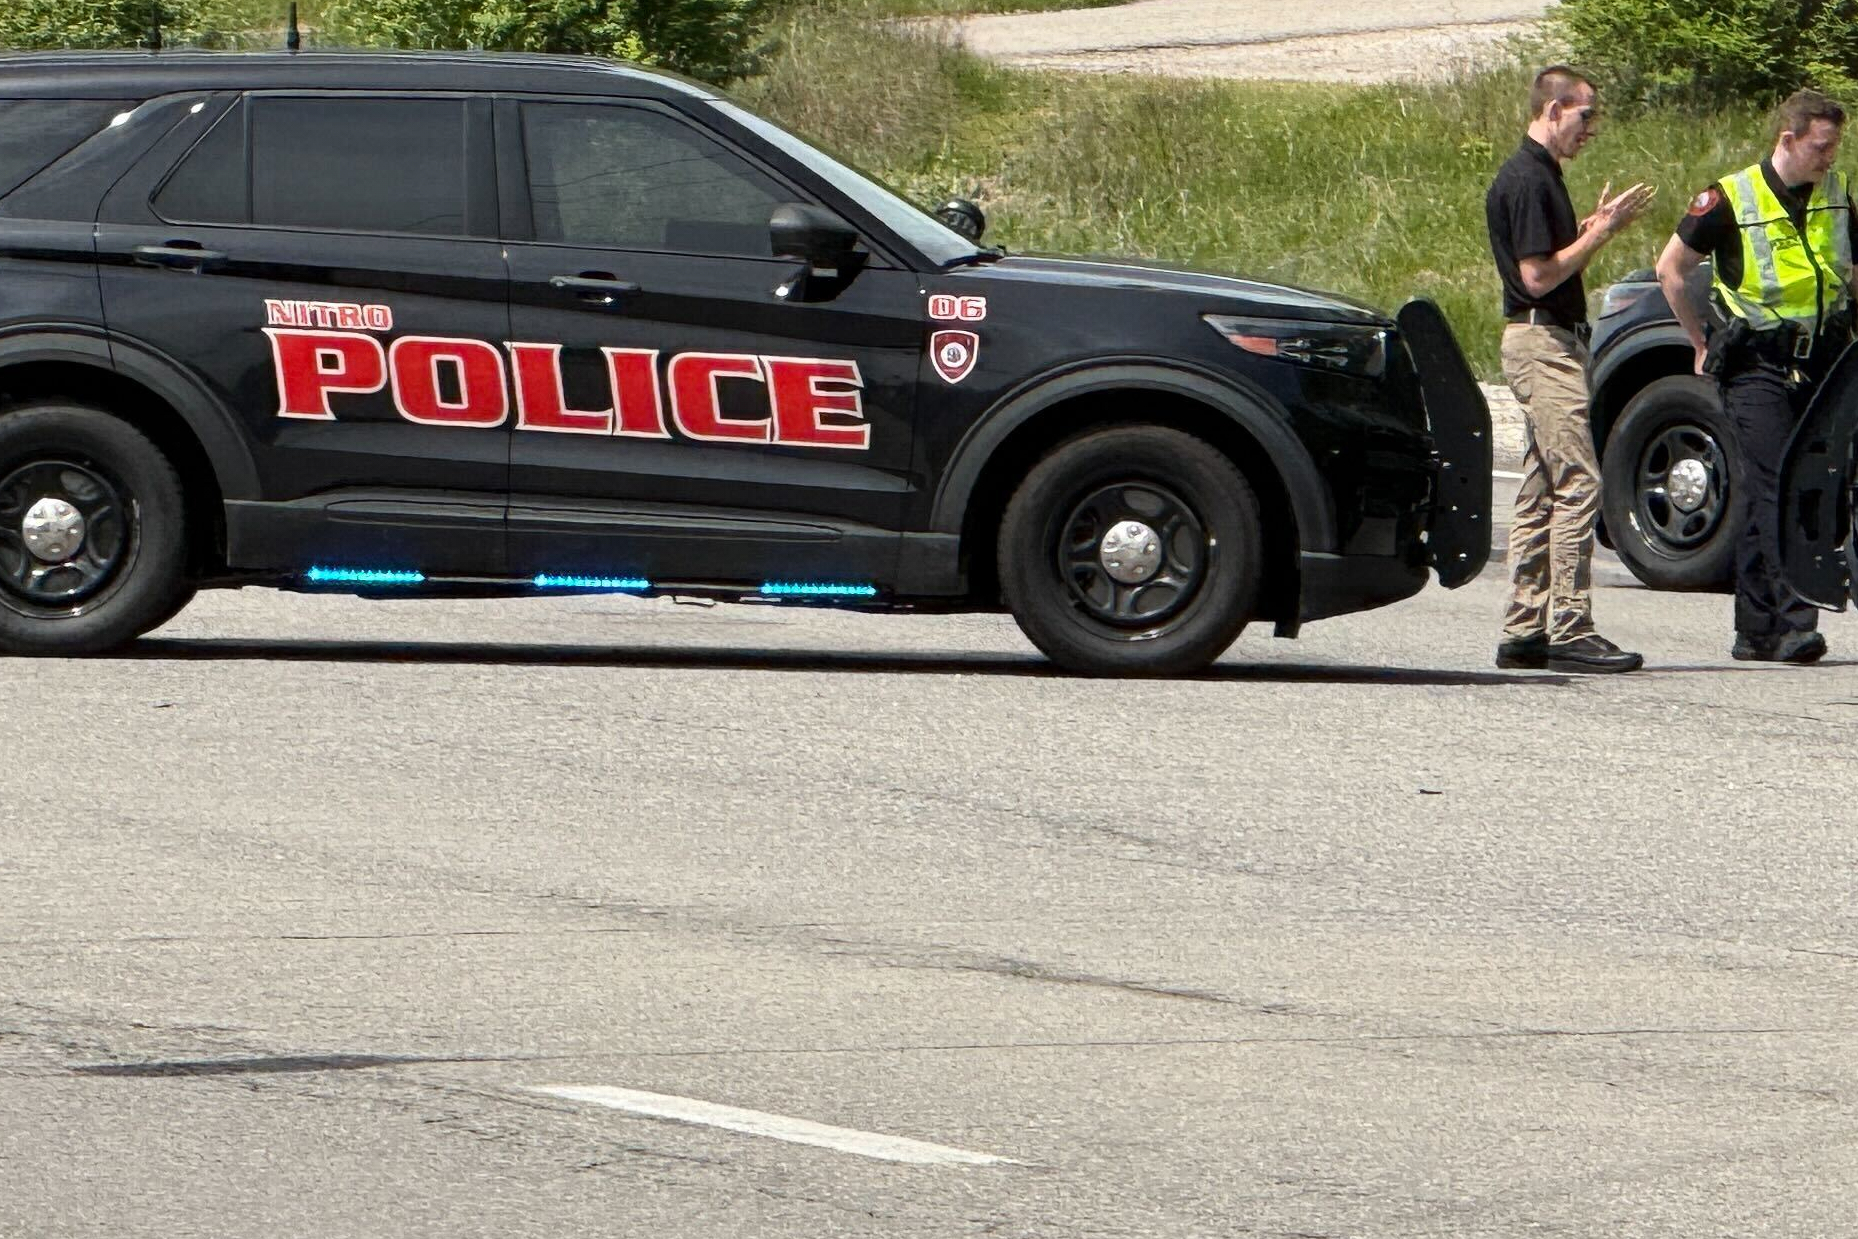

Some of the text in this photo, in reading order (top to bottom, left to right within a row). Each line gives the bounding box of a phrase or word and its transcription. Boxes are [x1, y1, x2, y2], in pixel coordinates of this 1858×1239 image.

[264, 298, 393, 331] NITRO
[928, 294, 987, 321] 06
[262, 327, 871, 450] POLICE
